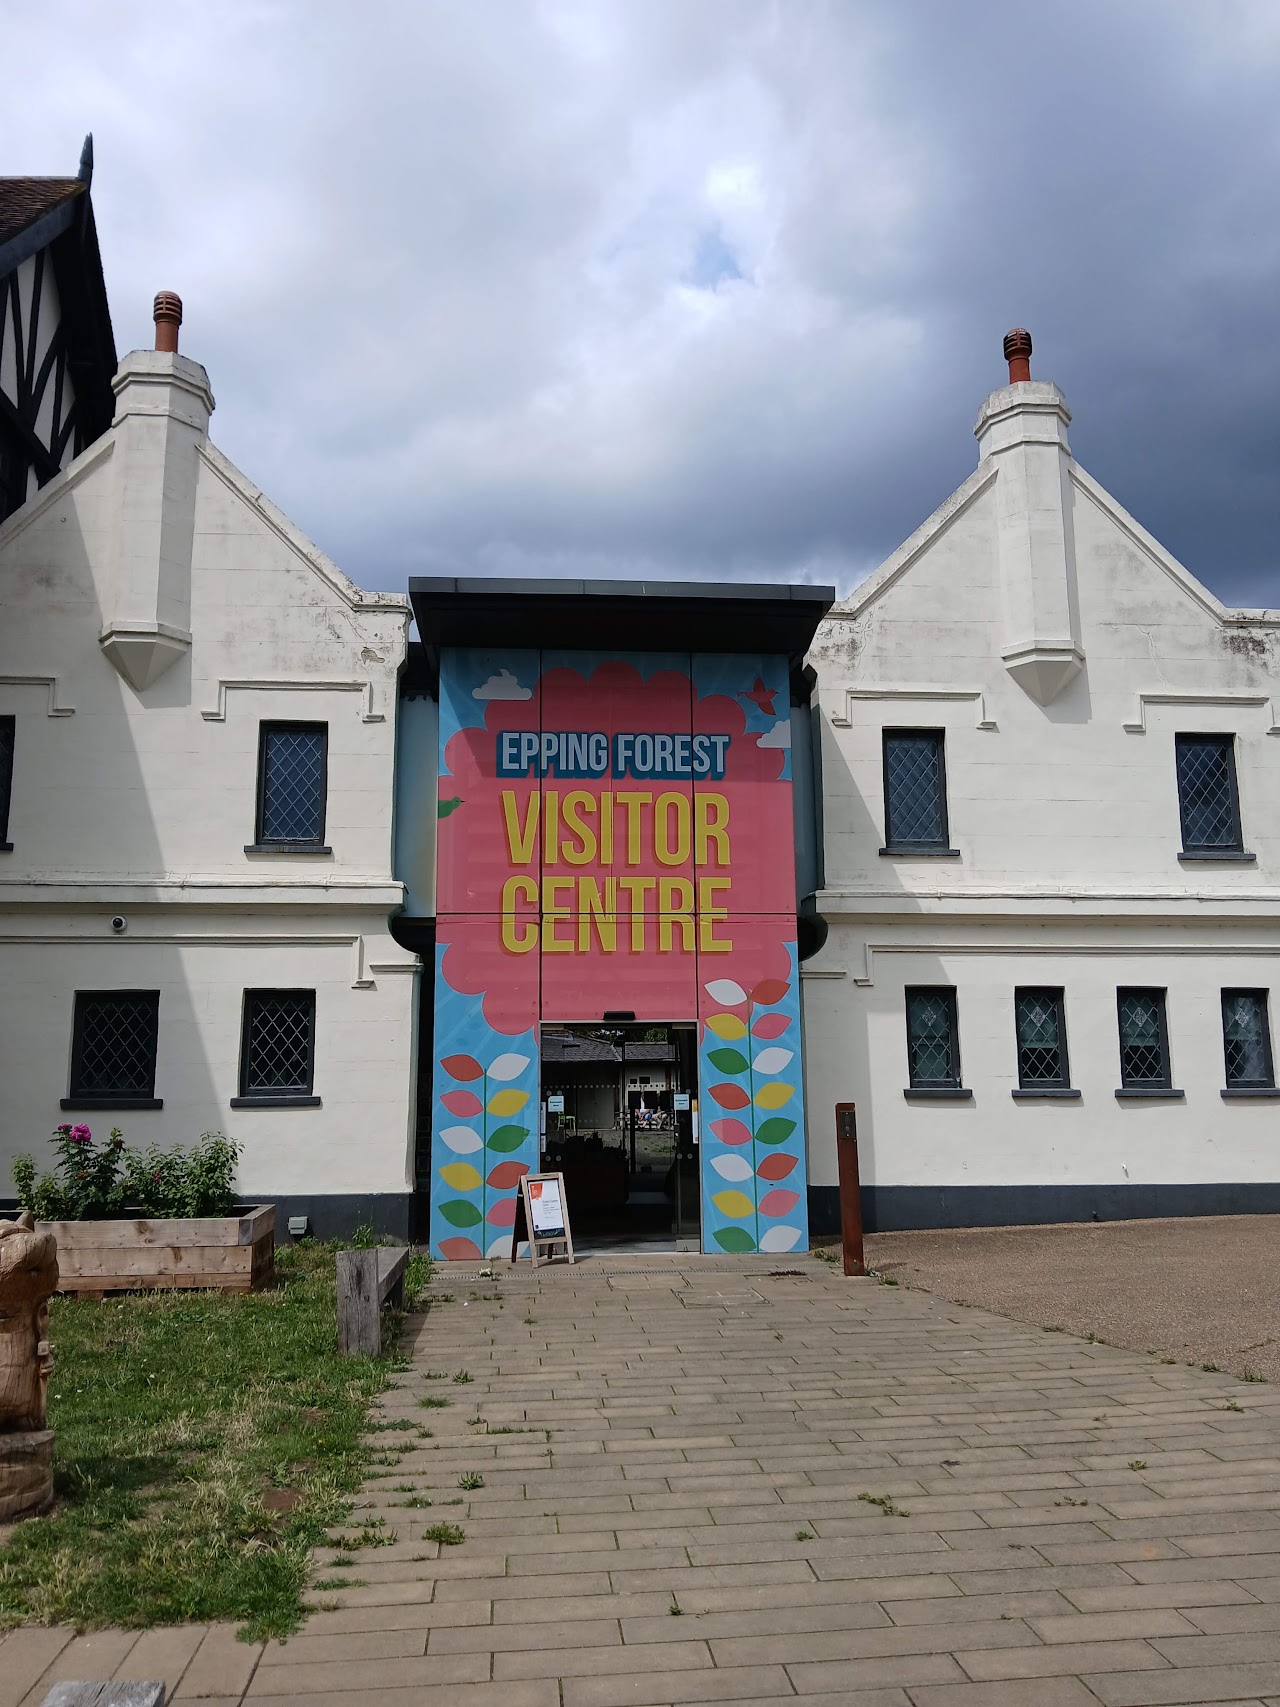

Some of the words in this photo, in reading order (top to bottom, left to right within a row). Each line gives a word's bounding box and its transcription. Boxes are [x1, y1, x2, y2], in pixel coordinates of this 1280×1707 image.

[502, 732, 608, 771] EPPING
[617, 734, 729, 773] FOREST
[502, 790, 731, 866] VISITOR
[502, 875, 733, 953] CENTRE
